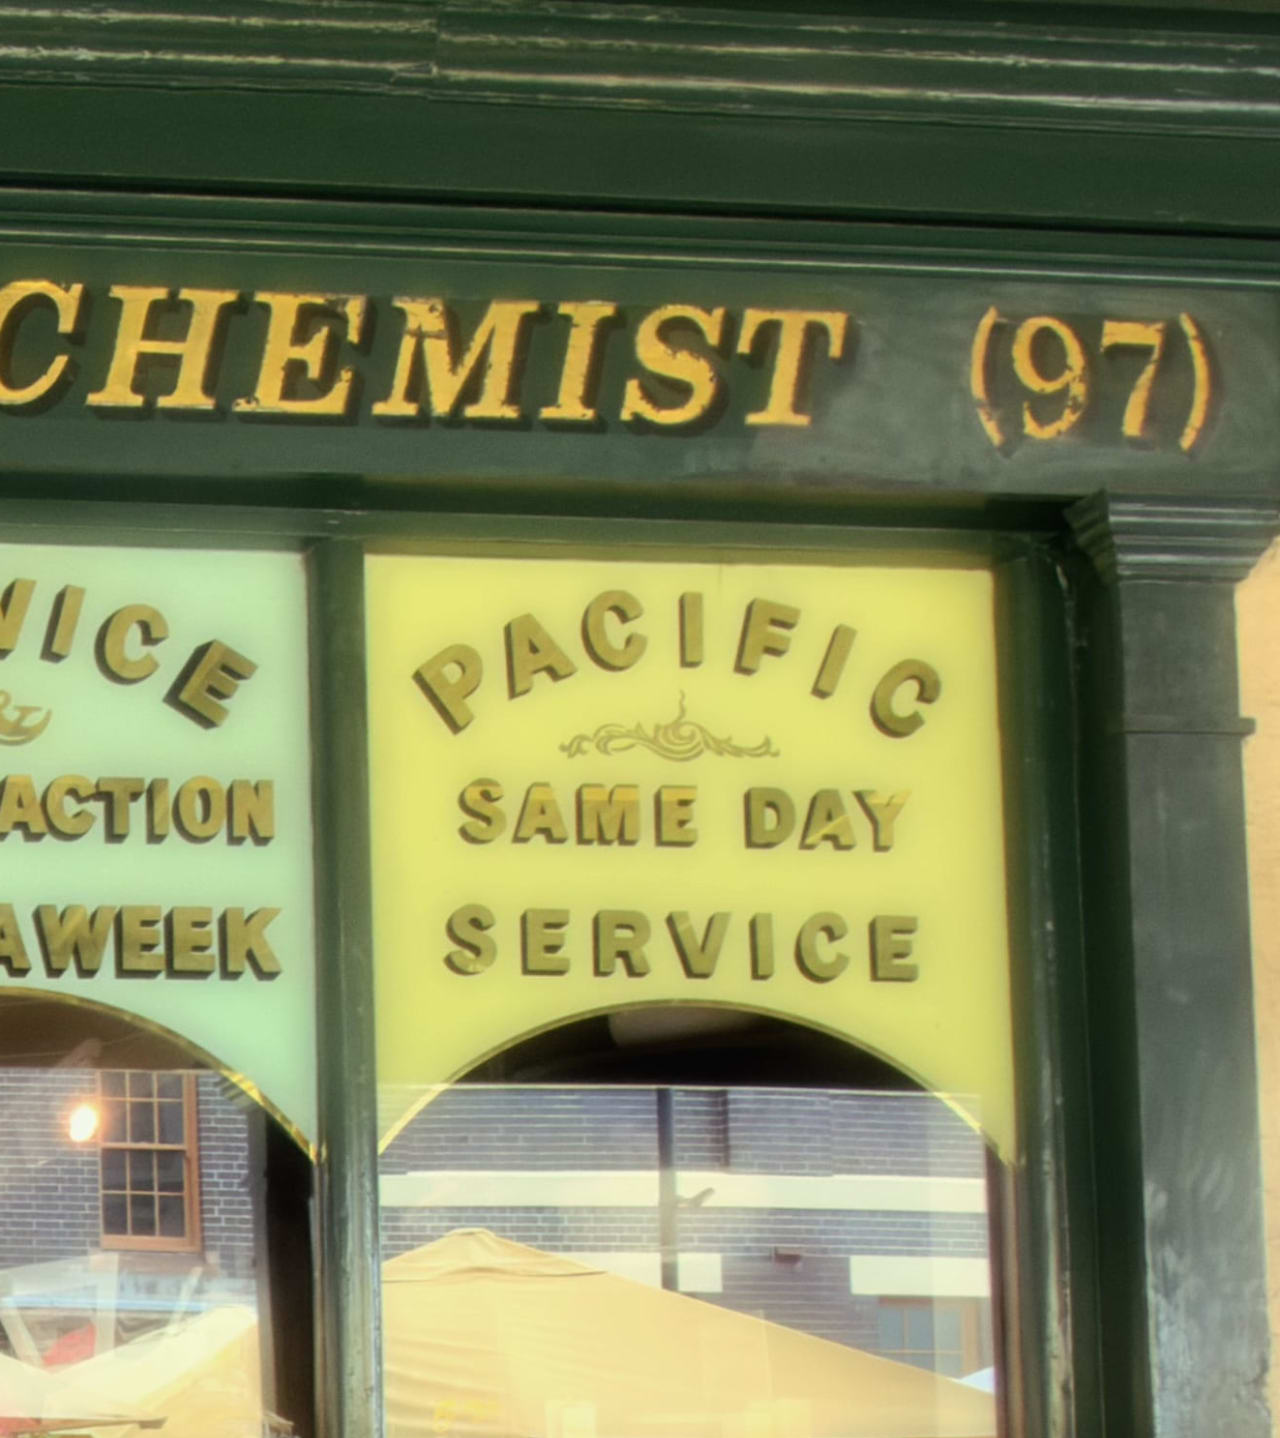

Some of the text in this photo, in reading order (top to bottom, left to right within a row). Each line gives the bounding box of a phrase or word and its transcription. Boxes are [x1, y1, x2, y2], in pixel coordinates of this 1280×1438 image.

[968, 306, 1214, 453] (97)
[411, 589, 942, 738] PACIFIC
[457, 778, 913, 853] SAME DAY
[32, 904, 283, 981] WEEK
[443, 904, 920, 983] SERVICE
